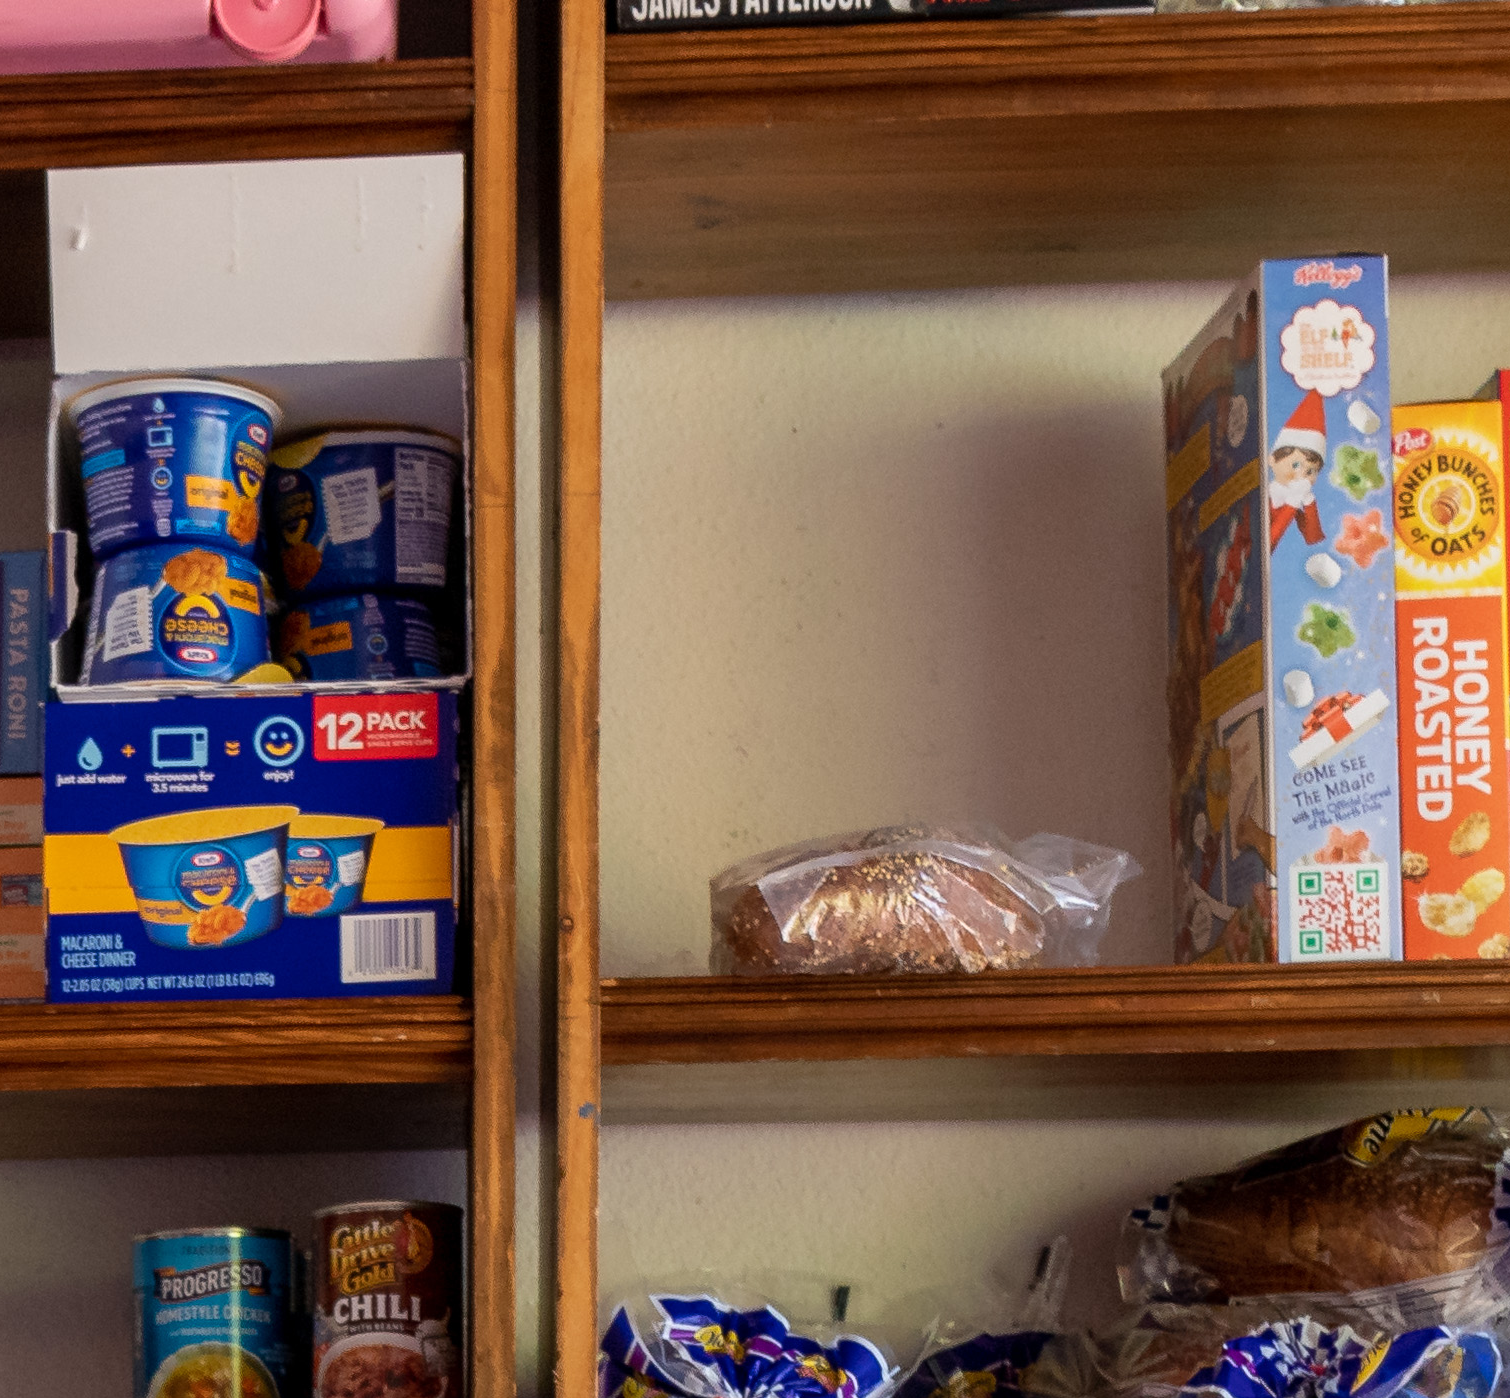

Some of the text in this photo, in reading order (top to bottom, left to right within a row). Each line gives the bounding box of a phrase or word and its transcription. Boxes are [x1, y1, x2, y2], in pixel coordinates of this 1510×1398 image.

[1394, 431, 1428, 456] Post
[1399, 455, 1494, 520] HONEY BUNCHES
[1431, 524, 1486, 555] OATS
[7, 588, 29, 739] PASTA RONI
[367, 710, 427, 731] PACK
[1412, 616, 1453, 822] ROASTED
[1452, 638, 1492, 795] HONEY
[317, 714, 365, 750] 12
[146, 770, 215, 783] microwave for
[264, 770, 294, 782] enjoy!
[1341, 756, 1367, 773] SEE
[57, 773, 127, 787] just add water
[169, 782, 208, 793] minutes
[61, 936, 114, 951] MACARONI
[61, 951, 136, 968] CHEESE DINNER
[160, 1264, 262, 1300] PROGRESSO
[333, 1294, 422, 1324] CHILI
